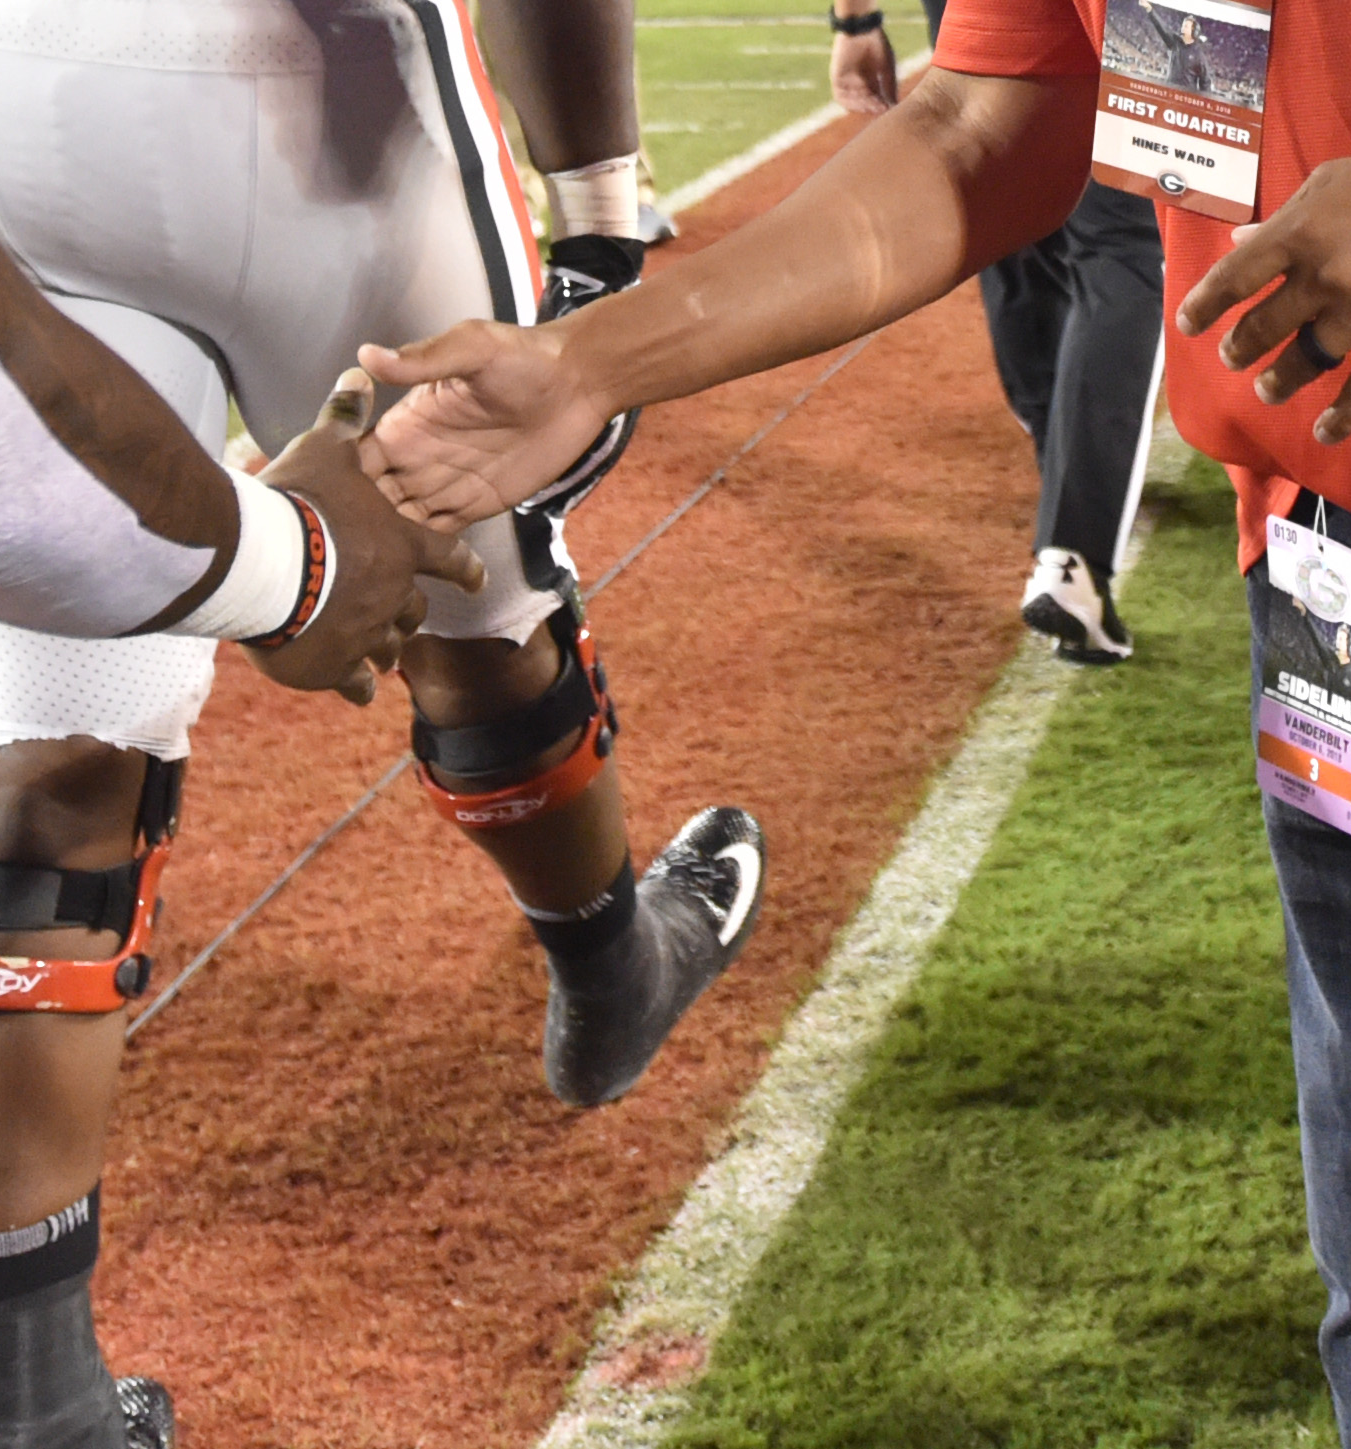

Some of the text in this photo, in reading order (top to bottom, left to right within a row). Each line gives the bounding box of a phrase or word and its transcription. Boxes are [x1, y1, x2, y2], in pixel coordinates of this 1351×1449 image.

[1174, 94, 1205, 108] OCTOBER
[1107, 93, 1251, 145] FIRST QUARTER
[1131, 136, 1216, 168] HINES WARD
[1274, 523, 1298, 545] 0130
[1284, 712, 1350, 753] VANDERBILT
[1288, 731, 1317, 751] OCTOBER
[1309, 757, 1320, 782] 3
[456, 794, 548, 823] DONJOY
